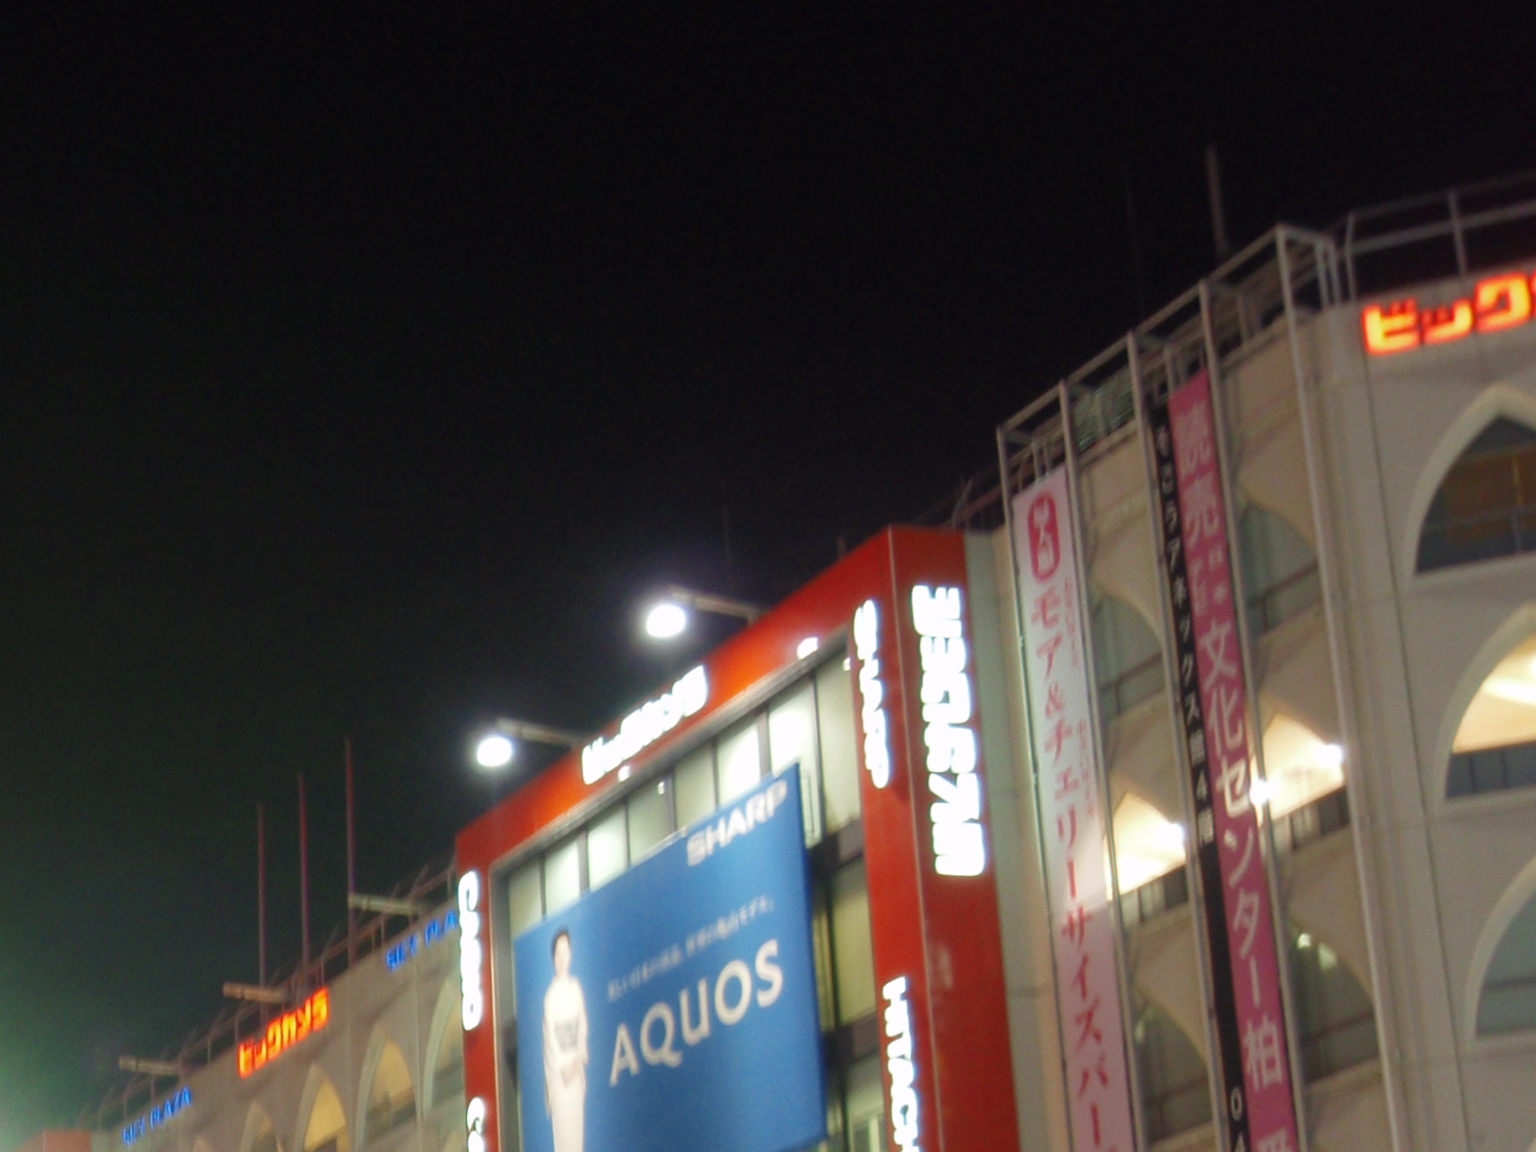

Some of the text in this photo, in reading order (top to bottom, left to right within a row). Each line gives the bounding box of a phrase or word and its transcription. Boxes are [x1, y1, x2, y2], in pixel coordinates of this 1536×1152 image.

[1362, 270, 1536, 356] ビック
[687, 780, 788, 866] SHARP
[609, 938, 785, 1088] AQUOS
[149, 1085, 193, 1131] PLAZA
